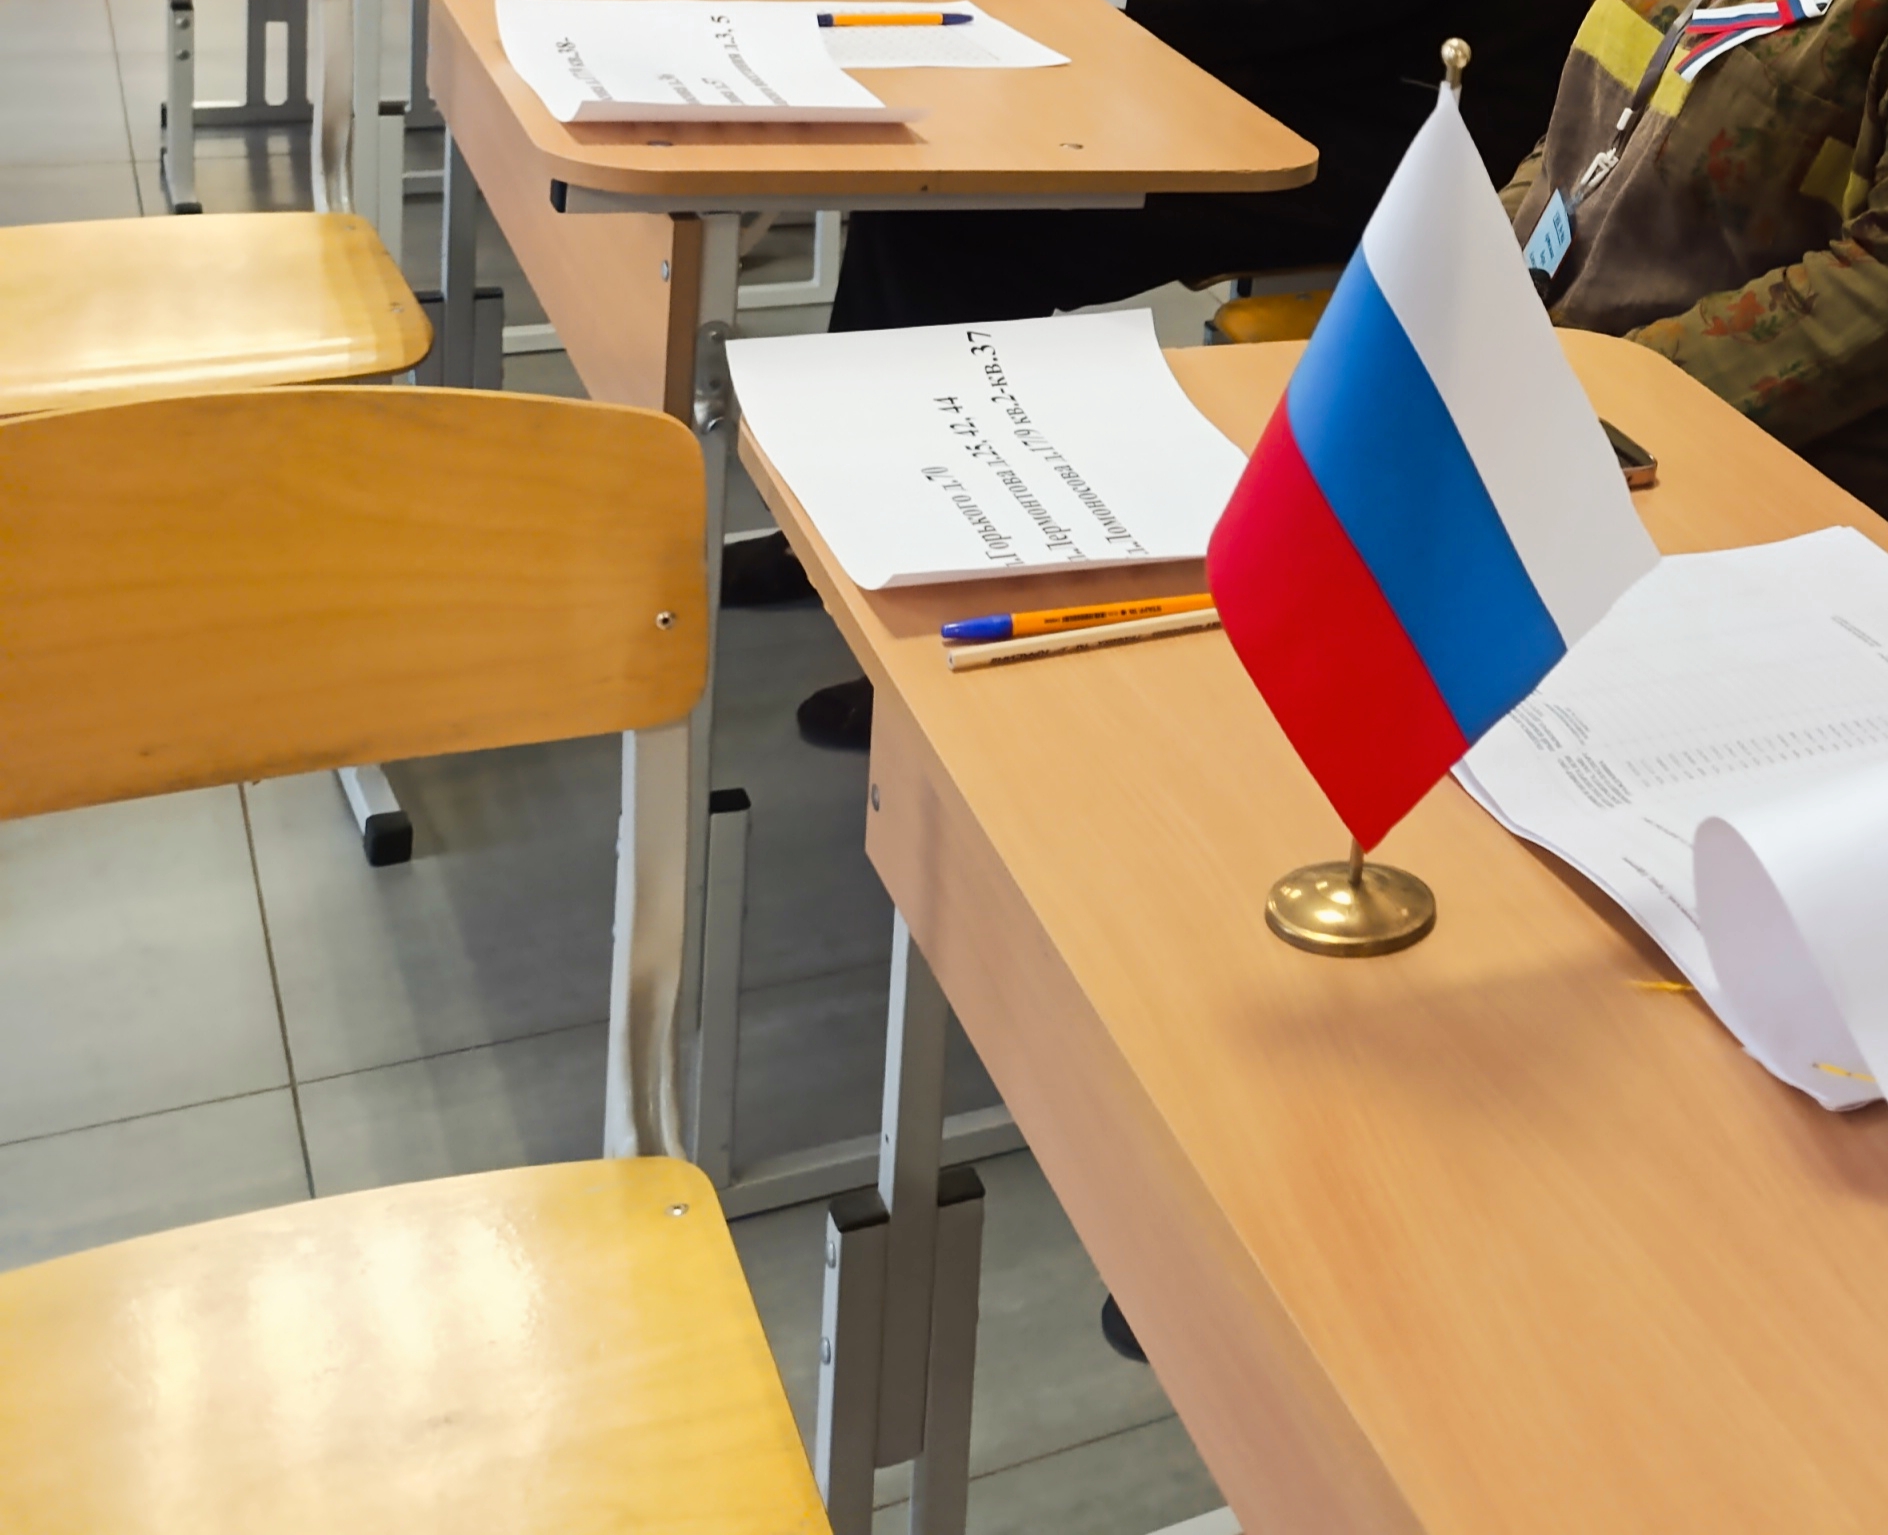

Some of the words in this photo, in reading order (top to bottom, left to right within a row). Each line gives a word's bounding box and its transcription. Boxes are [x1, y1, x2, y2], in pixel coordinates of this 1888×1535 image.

[933, 396, 963, 415] 44
[952, 494, 1025, 567] л.Горького
[996, 469, 1091, 562] л.Лермонтова
[1053, 464, 1150, 557] л.Ломоносова
